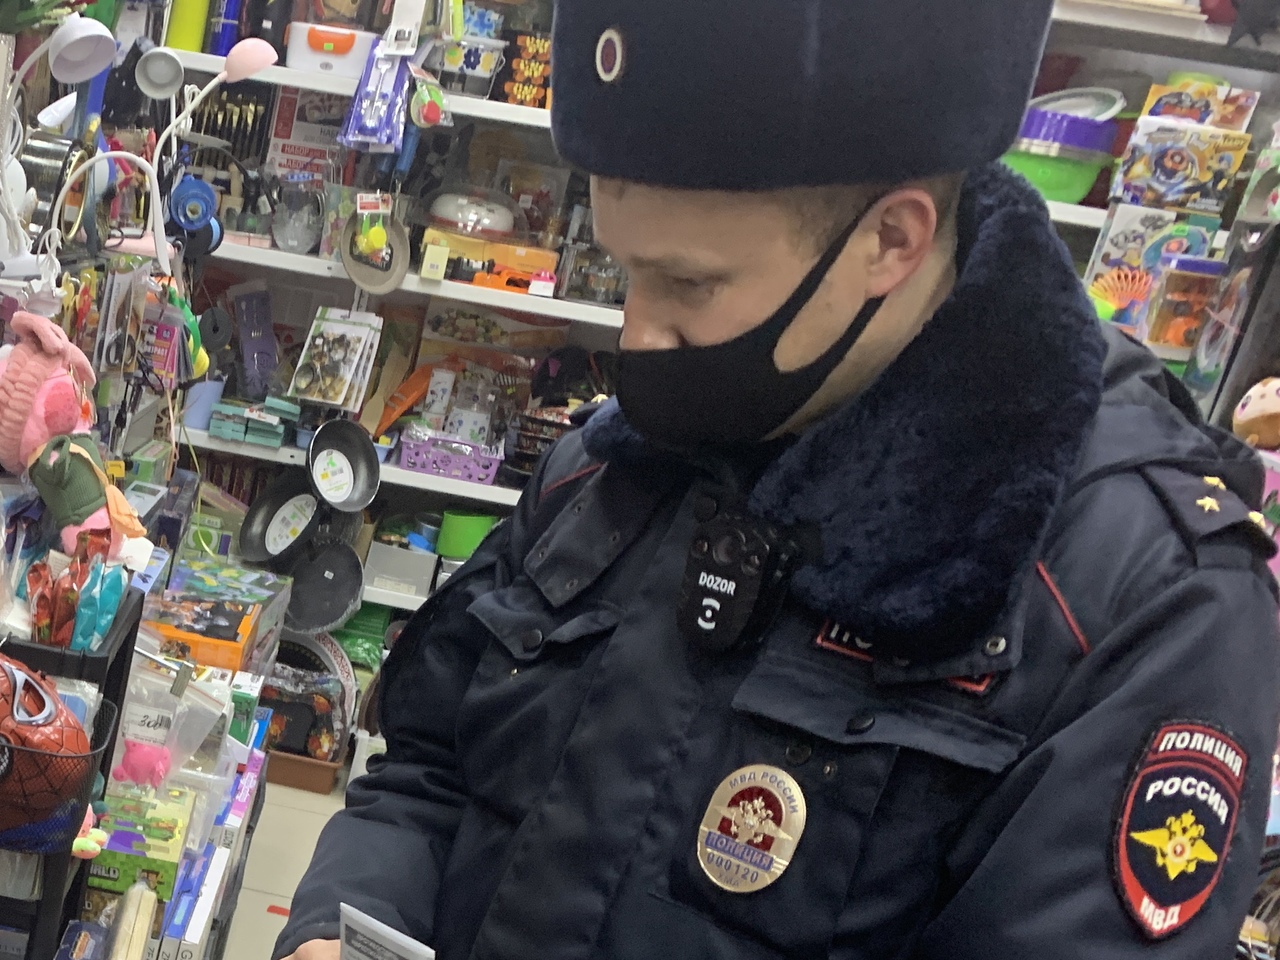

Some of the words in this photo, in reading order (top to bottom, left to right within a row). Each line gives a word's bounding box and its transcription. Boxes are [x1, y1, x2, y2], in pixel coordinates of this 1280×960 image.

[699, 572, 736, 596] DOZOR
[1159, 731, 1243, 777] ПОЛИЦИЯ
[729, 771, 756, 789] МВД
[761, 771, 799, 814] РОССИИ
[1146, 777, 1229, 825] РОССИЯ
[706, 851, 759, 883] 000120
[707, 832, 771, 870] ПОЛИЦИЯ
[90, 863, 120, 880] RLD
[1140, 895, 1182, 931] МВД
